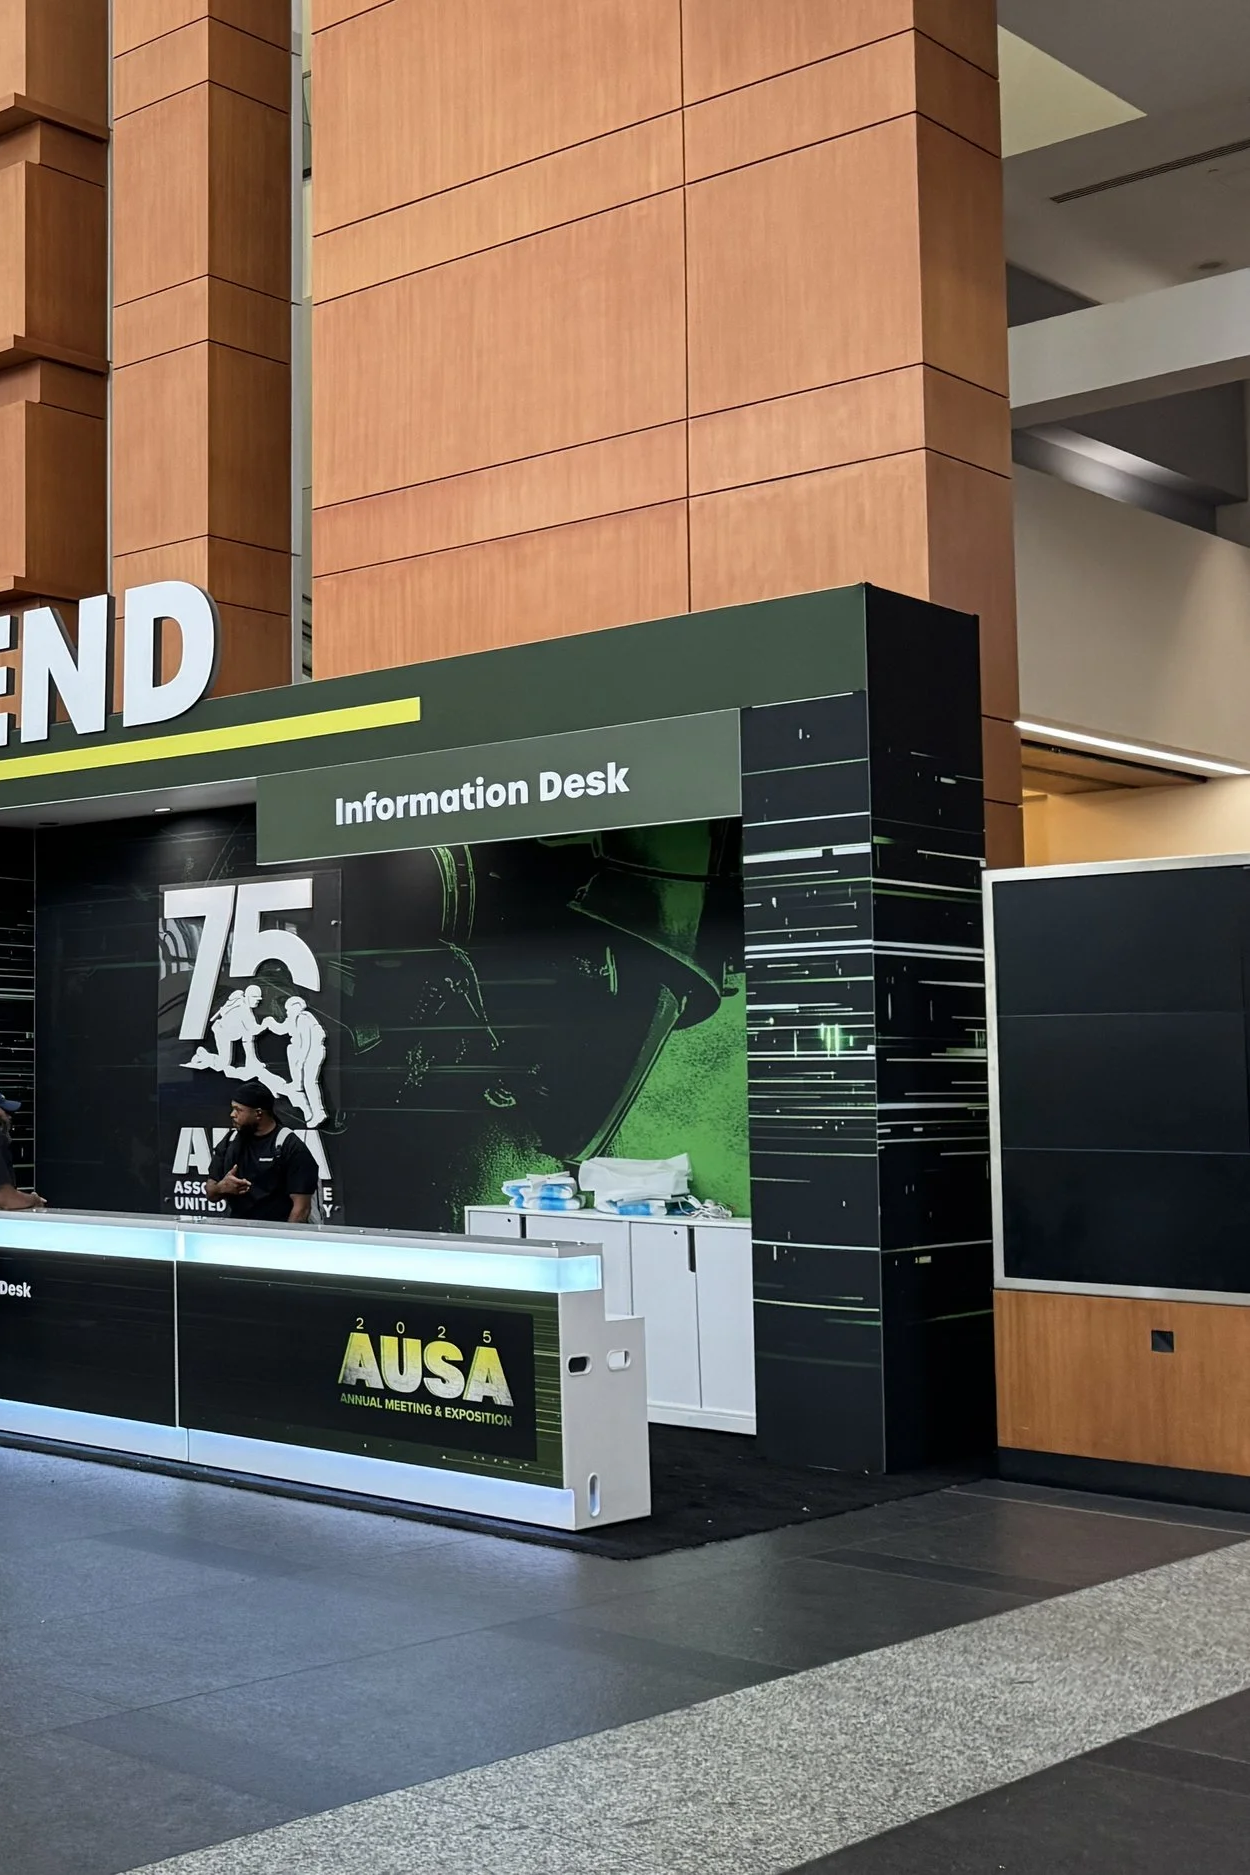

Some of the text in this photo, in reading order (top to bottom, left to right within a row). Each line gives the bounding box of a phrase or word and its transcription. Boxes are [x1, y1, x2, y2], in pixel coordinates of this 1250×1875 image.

[335, 762, 630, 826] Information Desk
[163, 878, 321, 1040] 75
[174, 1196, 227, 1212] UNITED
[0, 1280, 32, 1298] Desk
[338, 1332, 514, 1407] AUSA
[340, 1392, 513, 1428] ANNUAL MEETING & EXPOSITION
